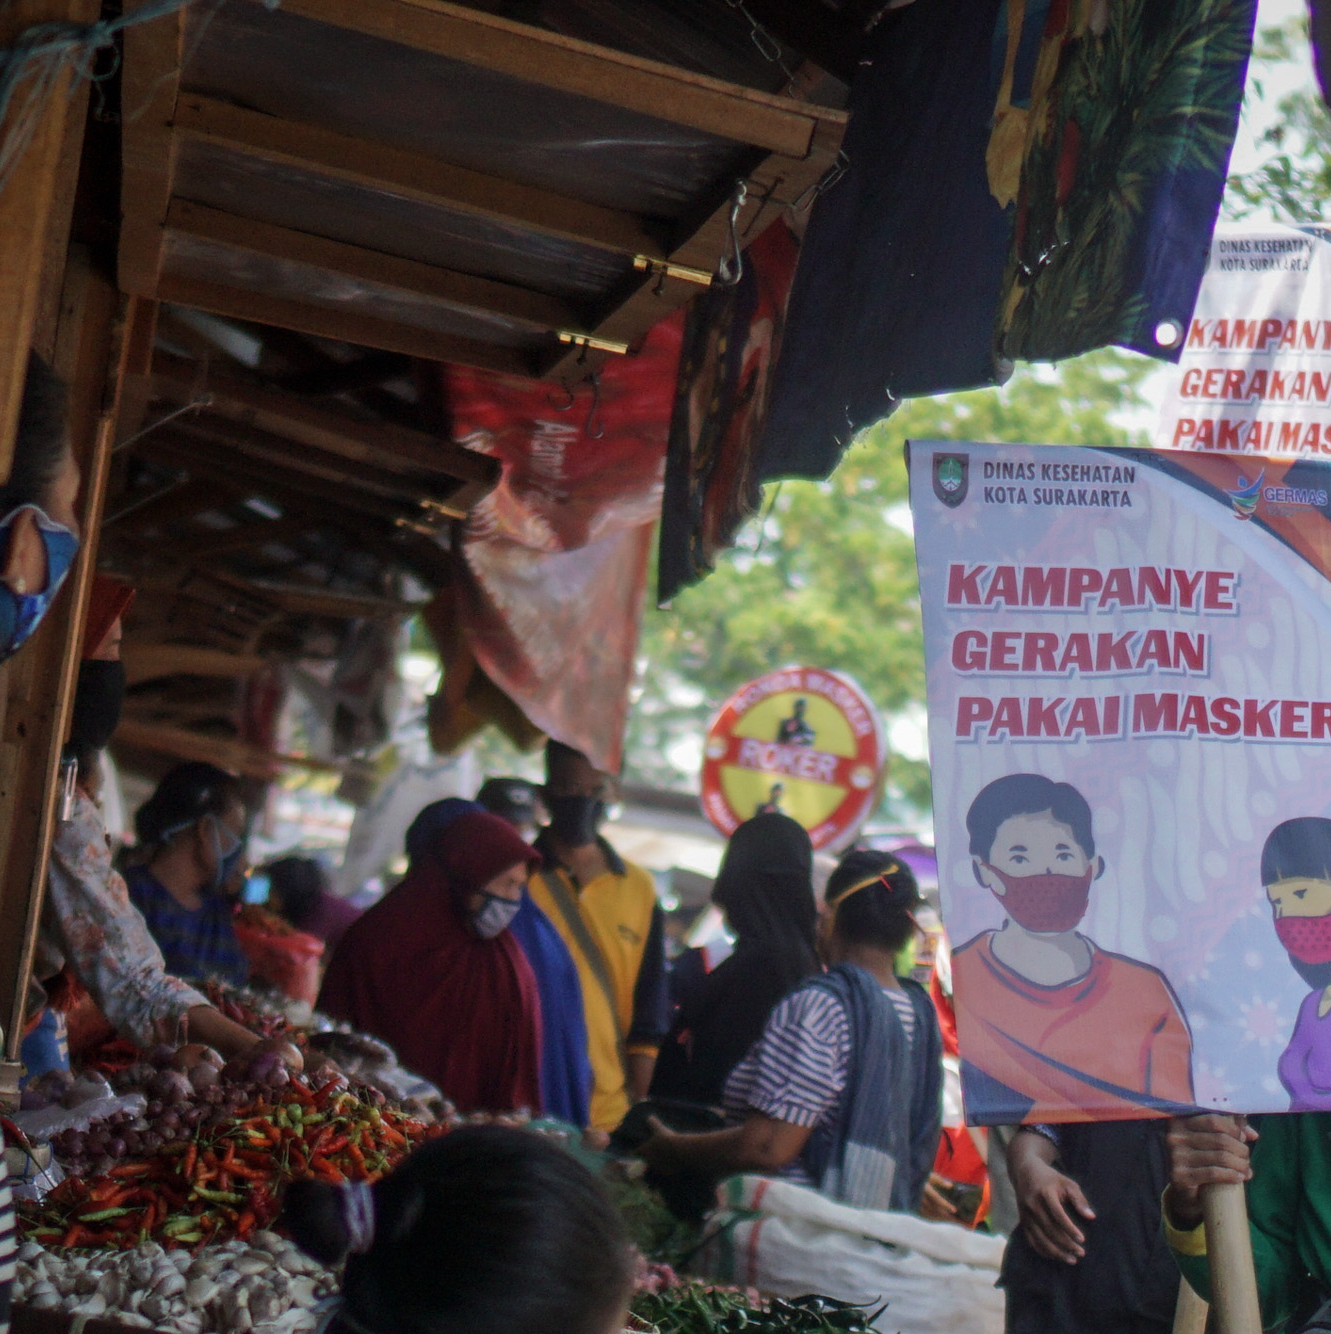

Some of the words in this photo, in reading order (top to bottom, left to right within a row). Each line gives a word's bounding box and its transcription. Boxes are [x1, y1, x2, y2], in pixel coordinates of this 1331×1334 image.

[1172, 418, 1275, 451] PAKAI
[983, 461, 1036, 481] DINAS
[1041, 463, 1136, 484] KESEHATAN
[983, 486, 1028, 505] KOTA
[1033, 487, 1132, 508] SURAKARTA
[1264, 486, 1328, 506] GERMAS
[947, 563, 1236, 610] KAMPANYE
[951, 629, 1206, 673] GERAKAN
[955, 695, 1121, 738] PAKAI
[737, 737, 839, 784] ROKER
